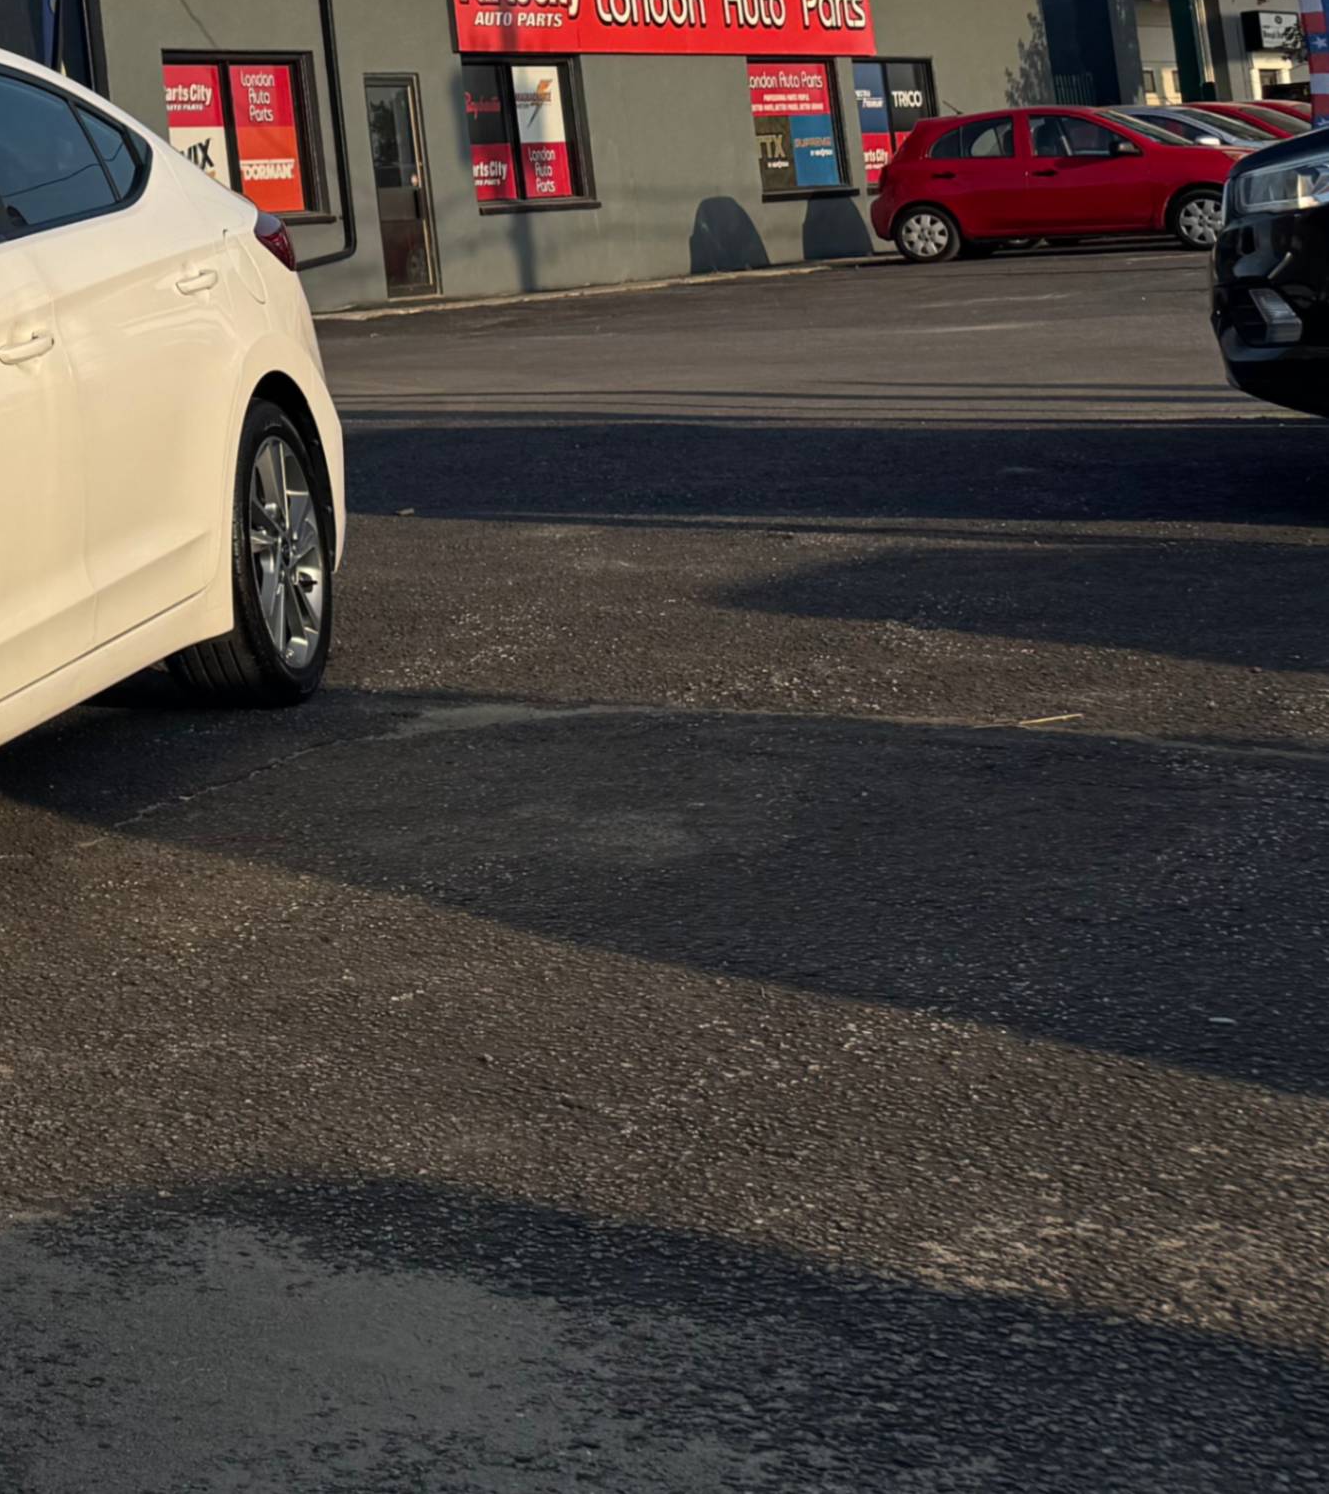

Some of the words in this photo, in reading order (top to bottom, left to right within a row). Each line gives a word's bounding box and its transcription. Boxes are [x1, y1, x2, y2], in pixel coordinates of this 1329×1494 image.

[474, 11, 513, 27] AUTO
[517, 12, 563, 28] PARTS
[241, 71, 274, 87] London
[749, 72, 778, 89] ondon
[779, 71, 800, 88] Auto
[801, 71, 823, 88] Parts
[248, 87, 271, 104] Auto
[891, 90, 922, 108] TRICO
[249, 105, 274, 122] Parts
[528, 147, 555, 162] London
[535, 162, 553, 177] Auto
[536, 177, 556, 193] Parts
